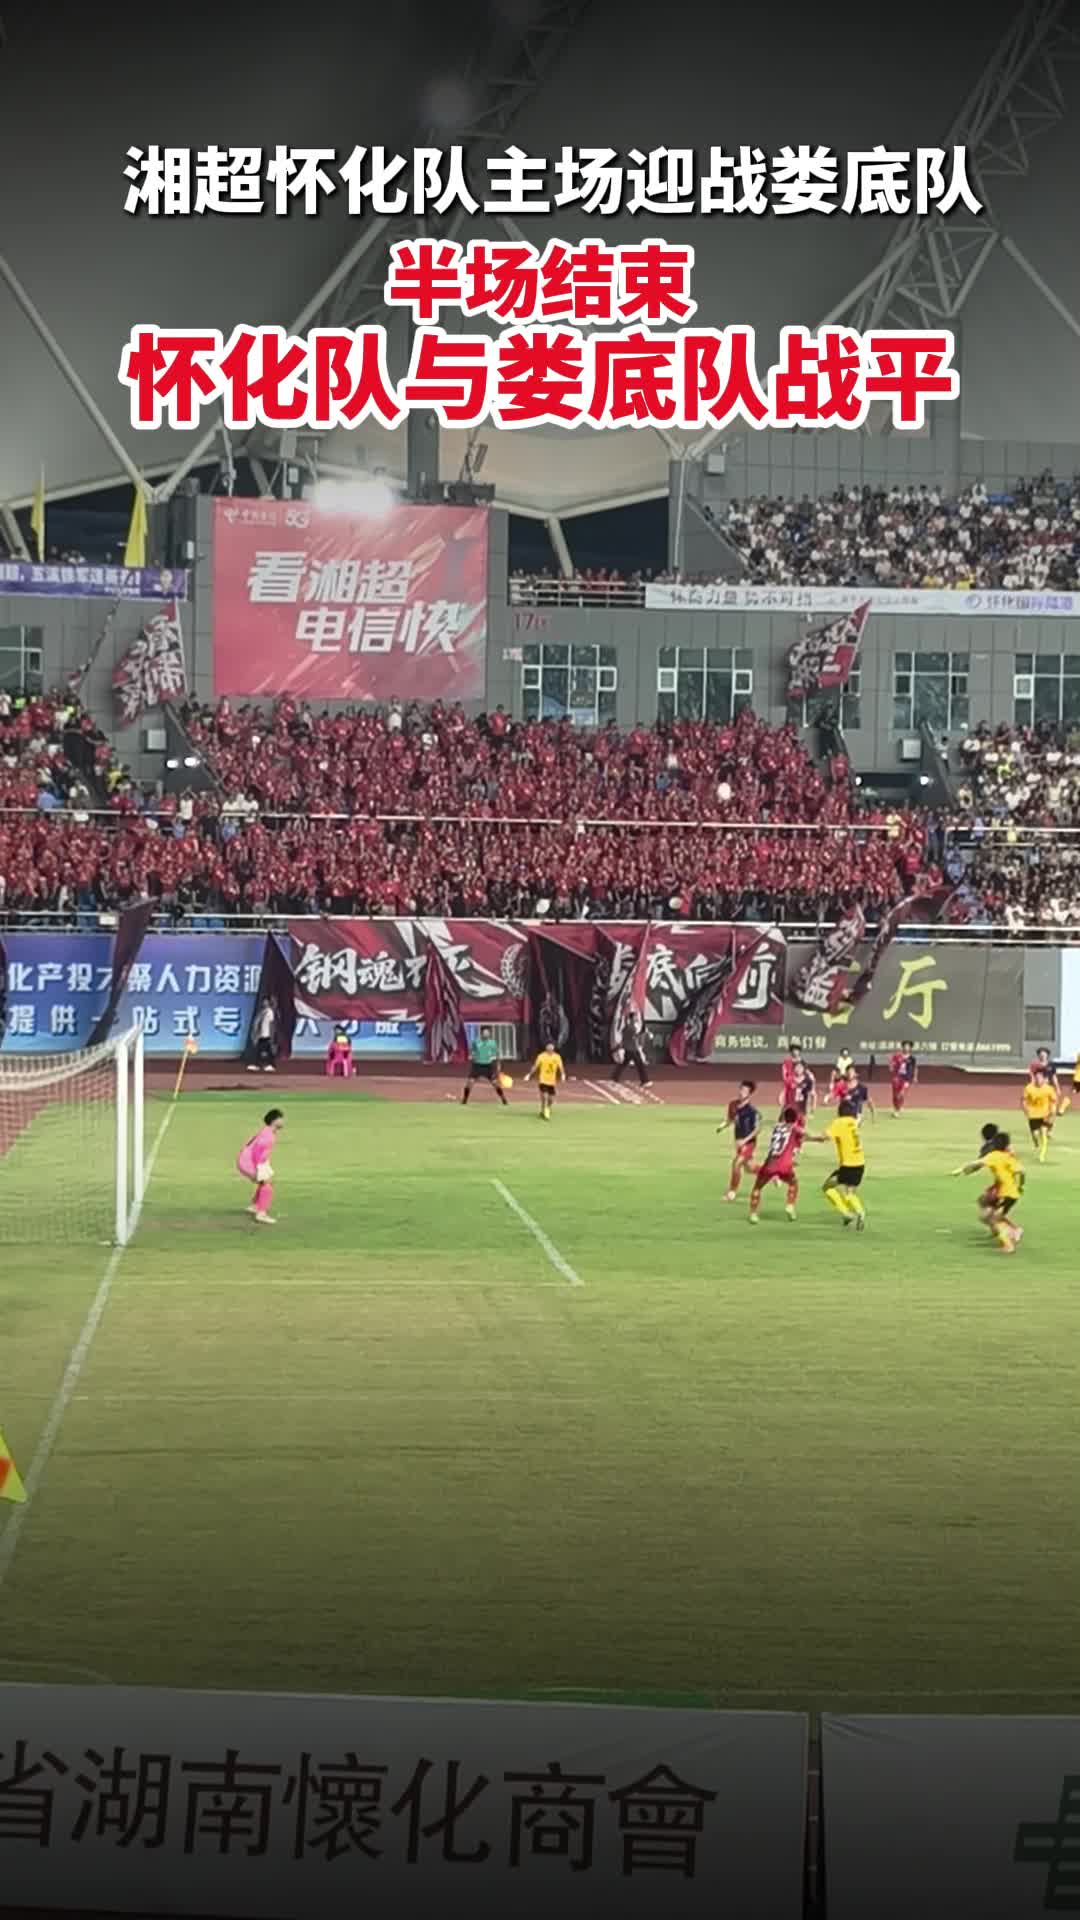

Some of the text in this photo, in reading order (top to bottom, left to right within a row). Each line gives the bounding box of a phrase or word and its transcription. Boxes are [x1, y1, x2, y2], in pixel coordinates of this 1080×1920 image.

[248, 551, 413, 603] 看湘超
[296, 600, 460, 655] 电信快
[0, 1739, 719, 1879] 省湖南懷化商會
